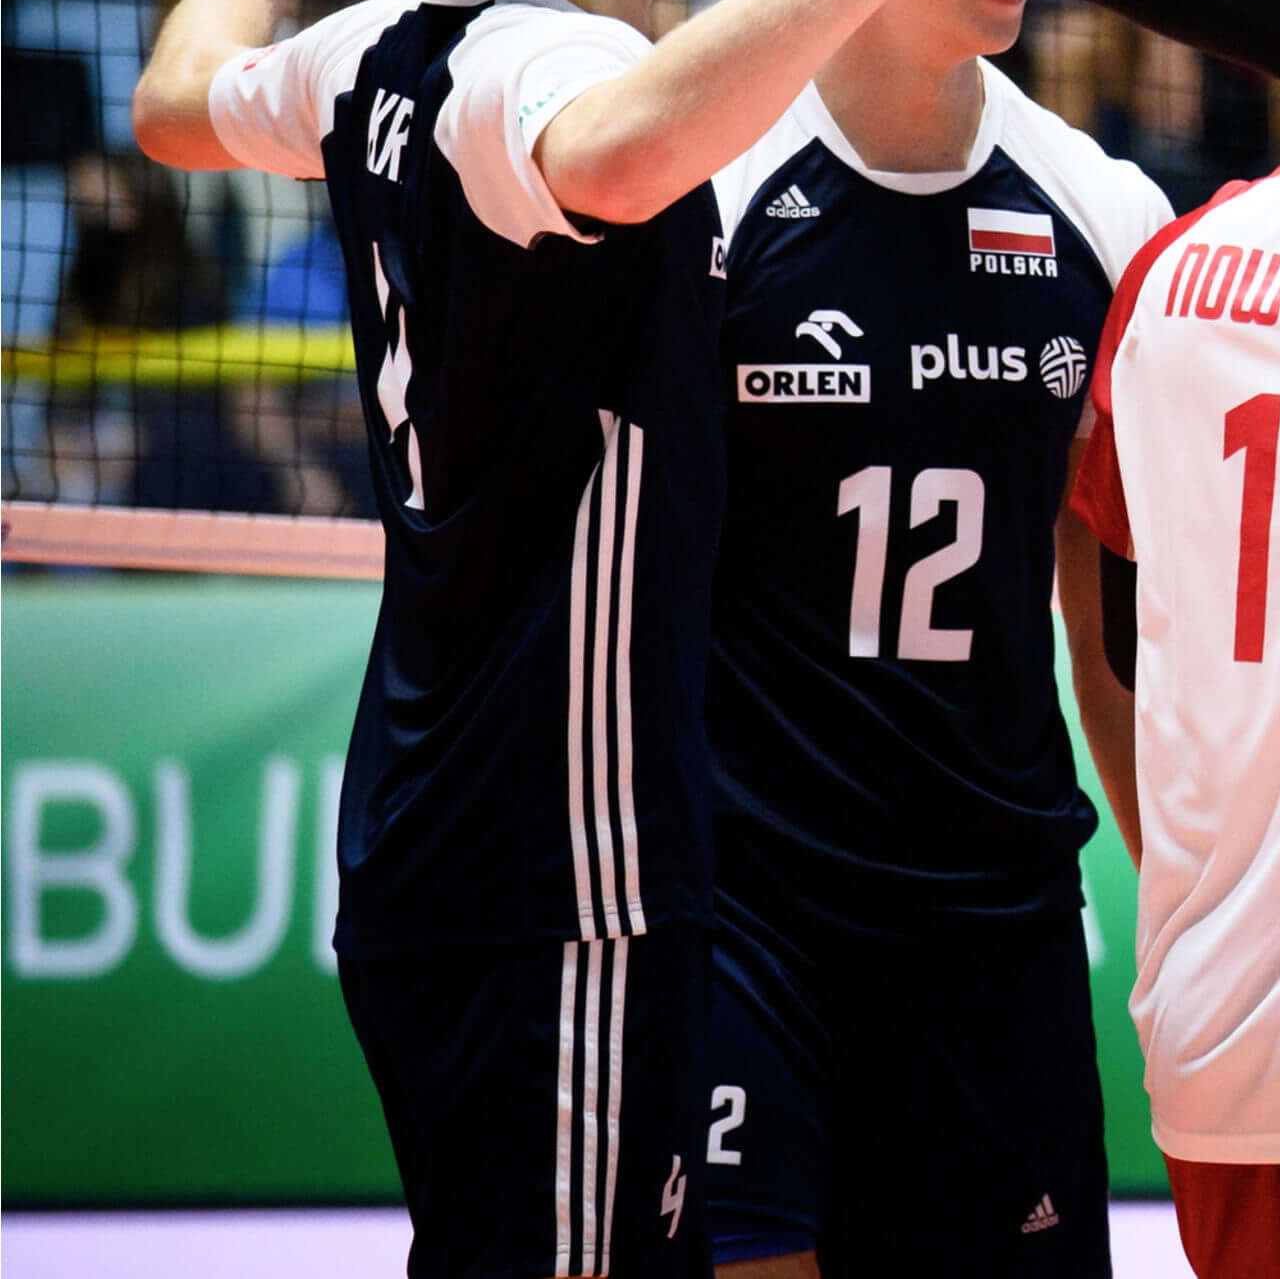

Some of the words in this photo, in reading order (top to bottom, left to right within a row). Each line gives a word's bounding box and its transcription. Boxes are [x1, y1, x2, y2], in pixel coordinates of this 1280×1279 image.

[765, 205, 821, 219] adidas
[969, 252, 1059, 278] POLSKA
[910, 333, 1028, 390] plus
[745, 371, 862, 397] ORLEN
[836, 465, 986, 662] 12
[660, 1153, 687, 1239] 4
